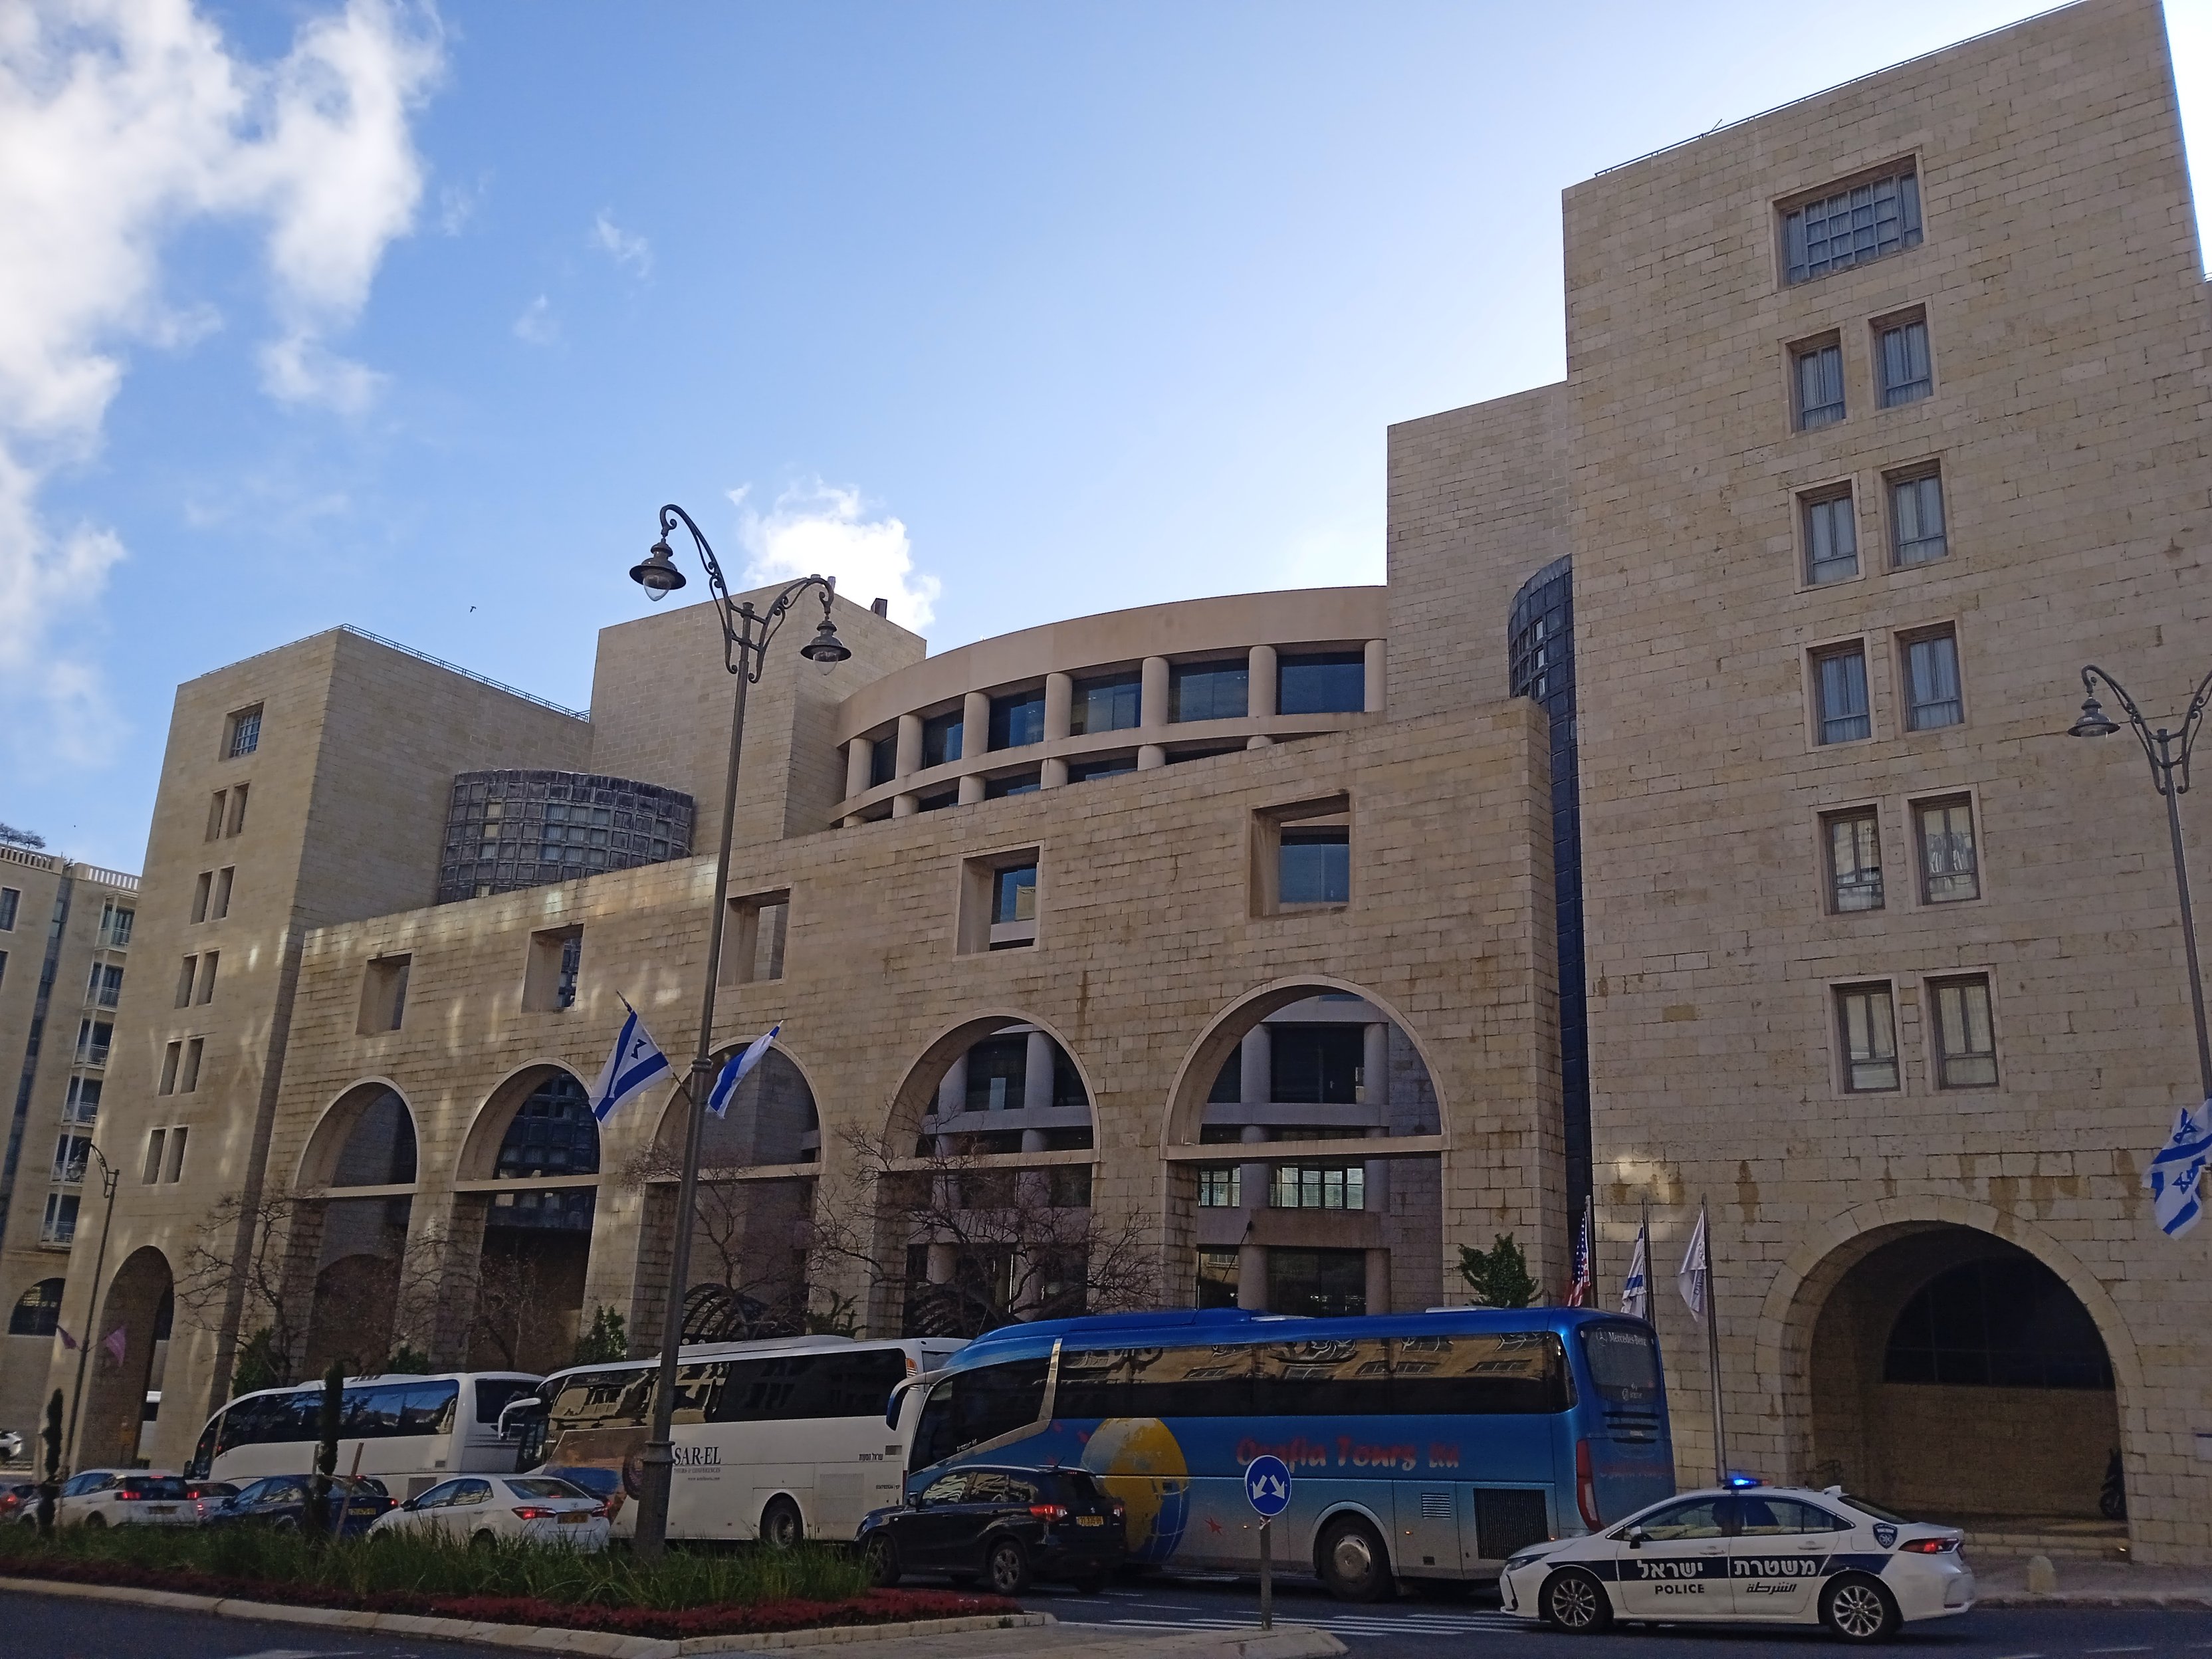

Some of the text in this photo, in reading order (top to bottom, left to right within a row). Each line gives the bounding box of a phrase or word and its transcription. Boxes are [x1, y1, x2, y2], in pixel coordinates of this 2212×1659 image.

[674, 1446, 721, 1466] SAR-EL
[1337, 1434, 1416, 1472] Tours
[1637, 1559, 1816, 1579] משטרת ישראל
[1655, 1583, 1705, 1595] POLICE
[1746, 1581, 1797, 1595] الشرطة
